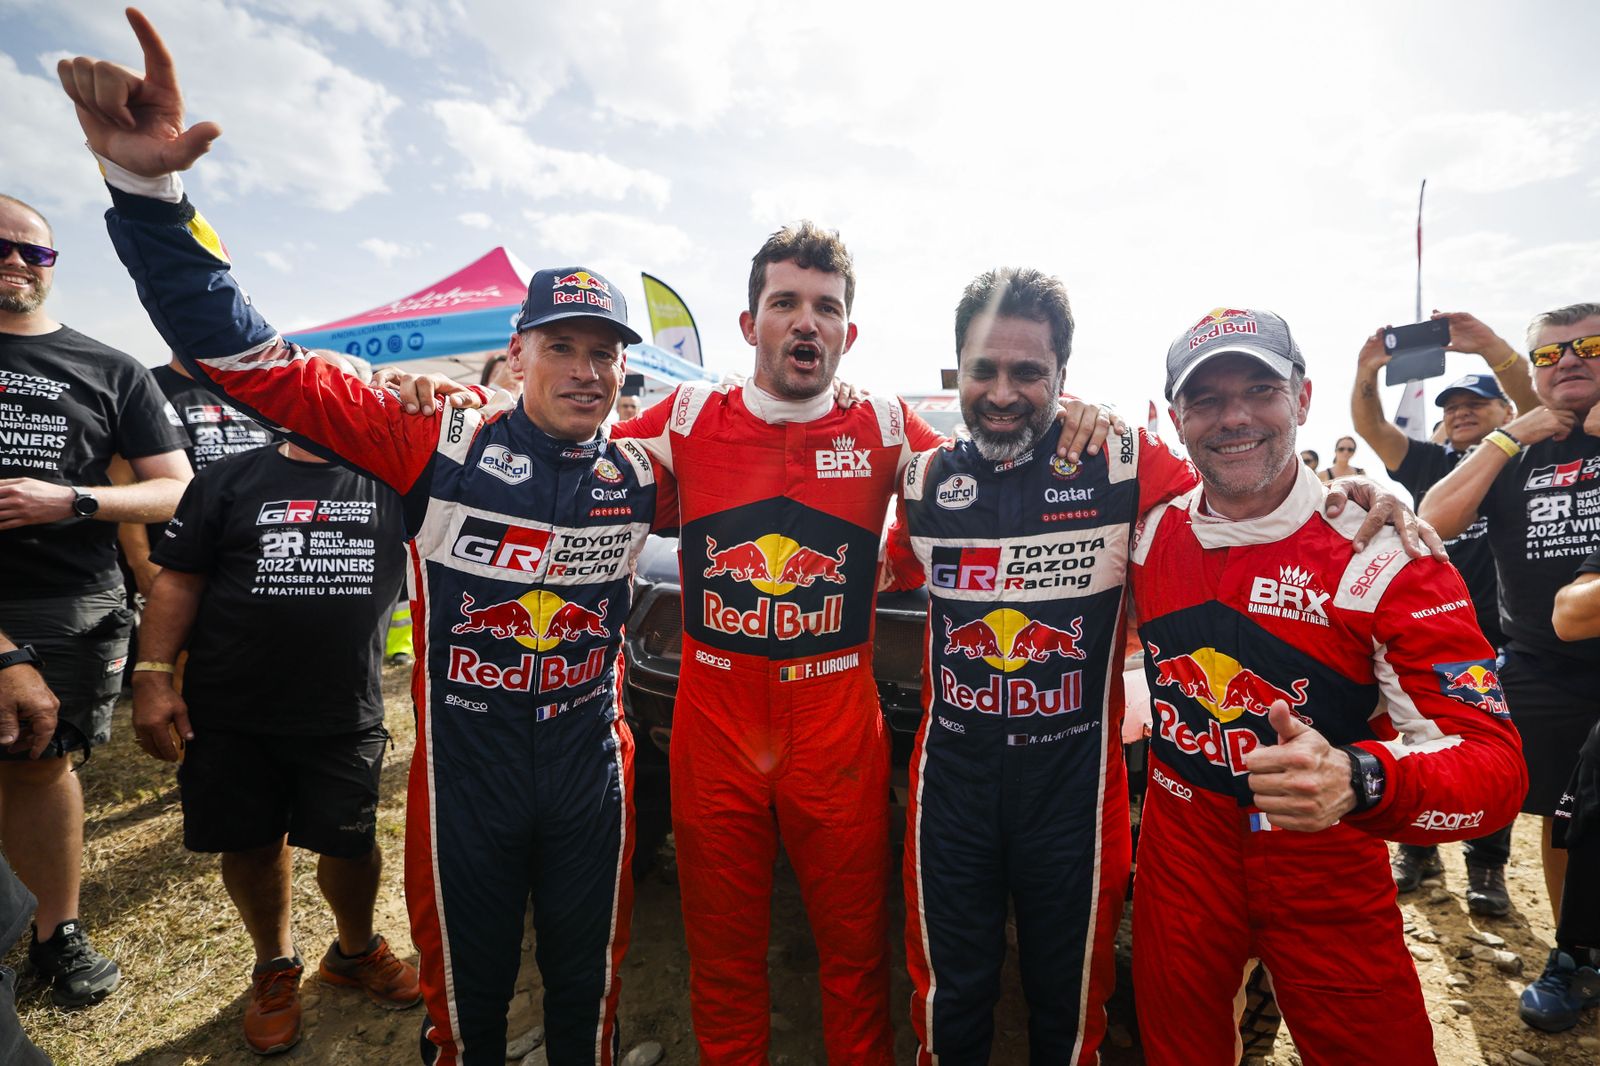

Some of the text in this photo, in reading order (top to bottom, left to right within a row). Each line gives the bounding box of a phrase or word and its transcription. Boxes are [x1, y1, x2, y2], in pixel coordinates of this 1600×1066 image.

[553, 290, 613, 312] Red Bull
[1189, 320, 1257, 350] Red Bull
[449, 406, 465, 444] arco
[196, 427, 225, 445] 2R
[193, 445, 223, 456] 2022
[2, 457, 59, 471] BAUMEL
[483, 456, 527, 475] eurol
[815, 449, 872, 471] BRX
[591, 487, 628, 501] Qatar
[940, 485, 974, 500] eurol
[1044, 487, 1094, 503] Qatar
[317, 507, 372, 515] GAZOO
[319, 500, 377, 509] TOYOTA
[589, 506, 633, 517] ooredoo
[1530, 494, 1572, 523] 2R
[315, 514, 370, 524] Racing
[1042, 510, 1098, 522] ooredoo
[309, 531, 343, 539] WORLD
[1526, 521, 1566, 539] 2022
[262, 531, 305, 558] 2R
[309, 539, 375, 549] RALLY-RAID
[560, 531, 632, 549] TOYOTA
[1008, 537, 1106, 560] TOYOTA
[1526, 540, 1540, 549] #1
[1543, 535, 1588, 548] NASSER
[309, 548, 376, 556] CHAMPIONSHIP
[453, 534, 543, 574] GR
[554, 547, 625, 563] GAZOO
[1543, 545, 1598, 558] MATHIE
[256, 558, 376, 573] 2022 WINNERS
[547, 562, 619, 577] Racing
[1006, 556, 1096, 576] GAZOO
[255, 574, 374, 584] #1 NASSER AL-ATTIYAH
[932, 563, 997, 590] GR
[1003, 573, 1092, 591] Racing
[251, 586, 373, 596] #1 MATHIEU BAUMEL
[1249, 575, 1331, 619] BRX
[703, 589, 845, 641] Red Bull
[1248, 602, 1330, 627] BAHRAIN RAID XTREME
[1411, 601, 1457, 619] RICHARD
[695, 649, 731, 671] sparco
[805, 652, 860, 679] F. LURQUIN
[447, 645, 609, 694] Red Bull
[940, 664, 1083, 718] Red Bull
[444, 693, 488, 712] sparco
[558, 701, 570, 713] M.
[1154, 698, 1228, 767] Red
[1152, 767, 1193, 803] sparco
